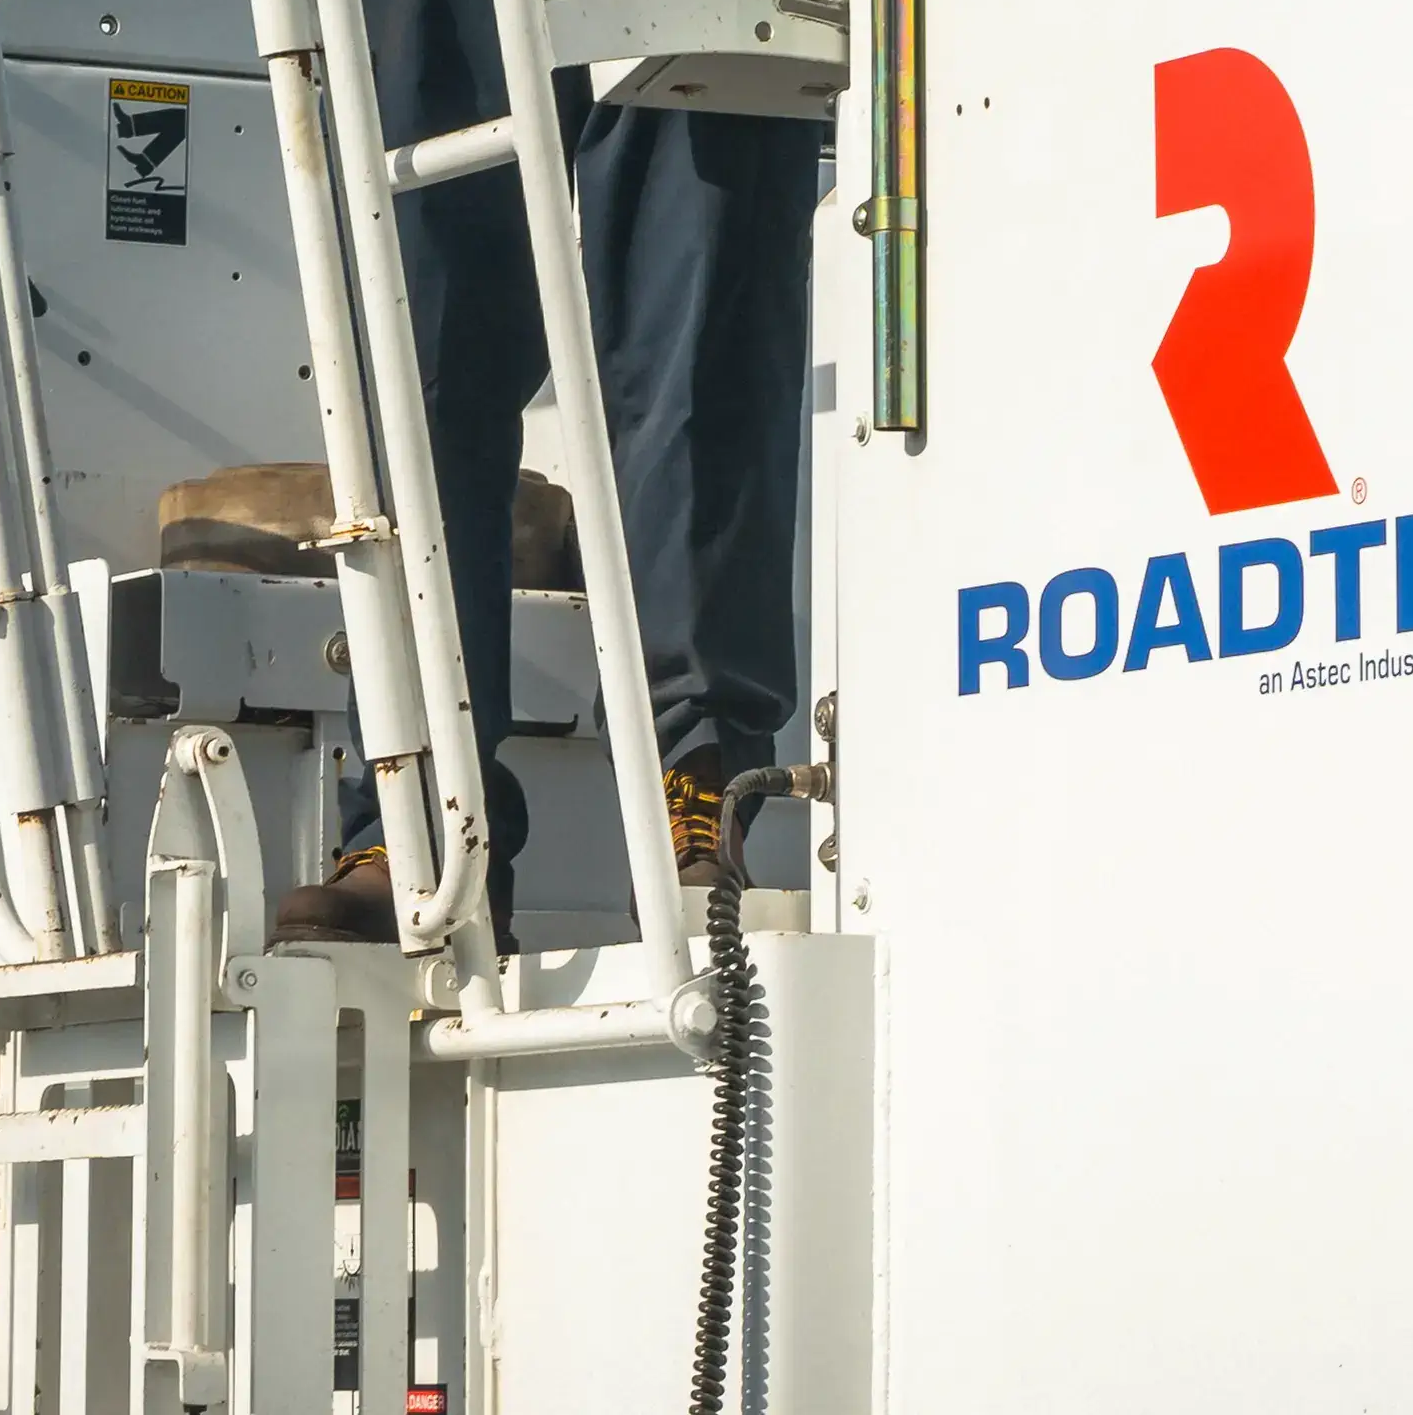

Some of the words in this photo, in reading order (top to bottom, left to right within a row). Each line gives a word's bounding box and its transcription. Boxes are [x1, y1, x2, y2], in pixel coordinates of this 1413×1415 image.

[128, 84, 185, 100] CAUTION
[1259, 672, 1282, 695] an
[1291, 661, 1351, 691] Astec
[408, 1394, 445, 1410] DANGER
